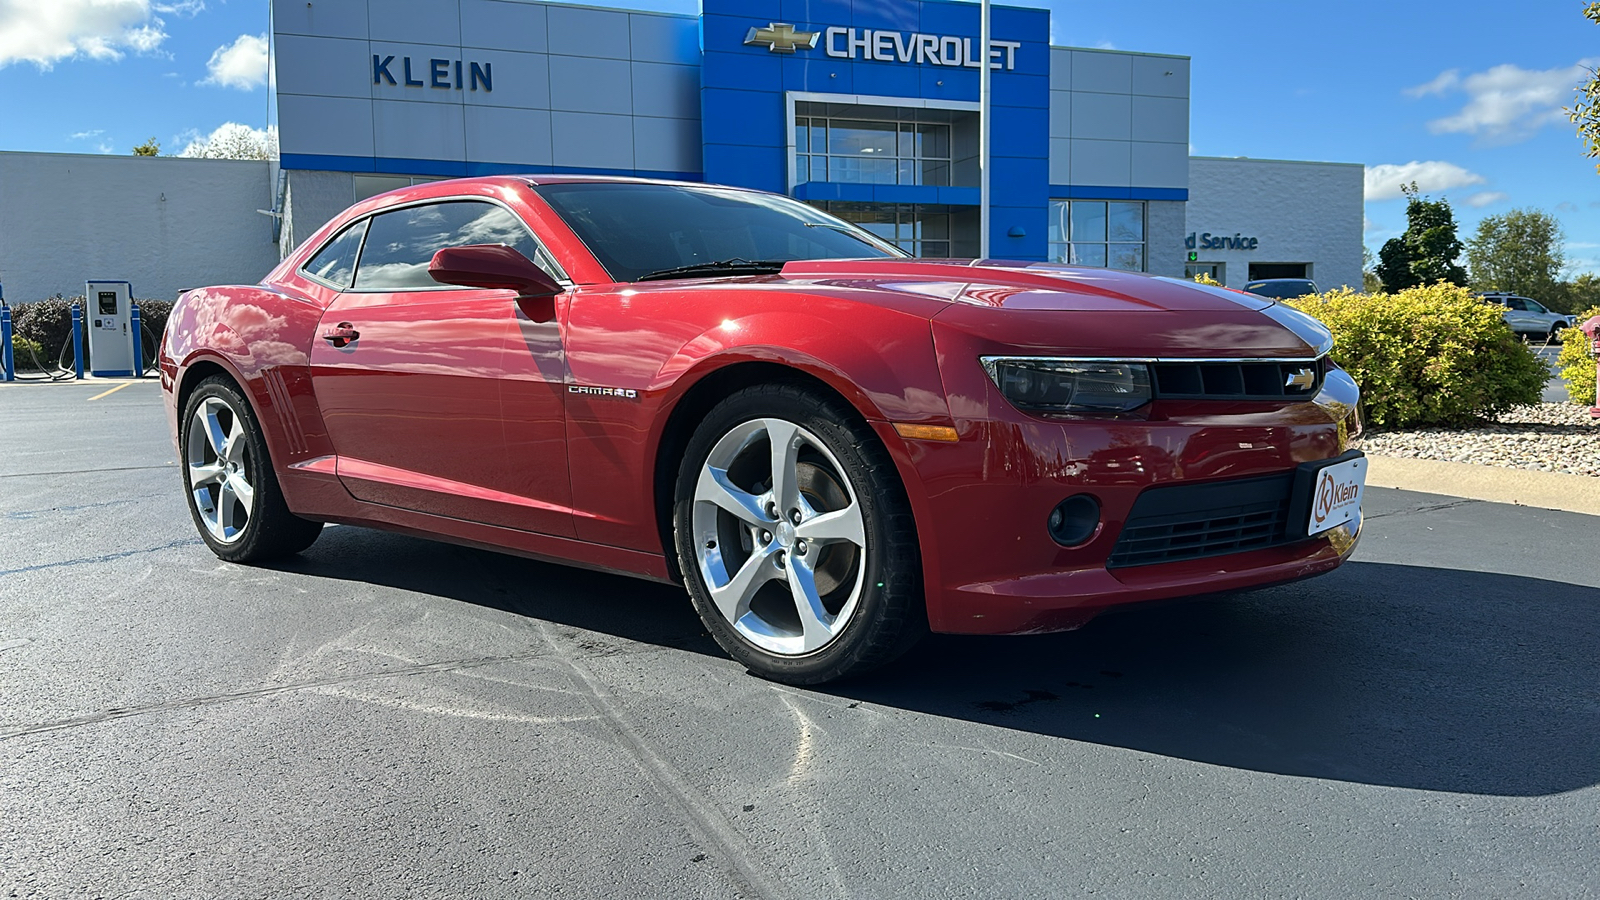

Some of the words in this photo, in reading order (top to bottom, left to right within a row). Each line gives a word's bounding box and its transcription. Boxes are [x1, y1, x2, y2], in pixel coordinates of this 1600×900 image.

[826, 27, 1021, 70] CHEVROLET
[373, 54, 493, 91] KLEIN
[1200, 232, 1258, 249] Service
[569, 386, 637, 398] CAMARO
[1333, 480, 1358, 504] Klein
